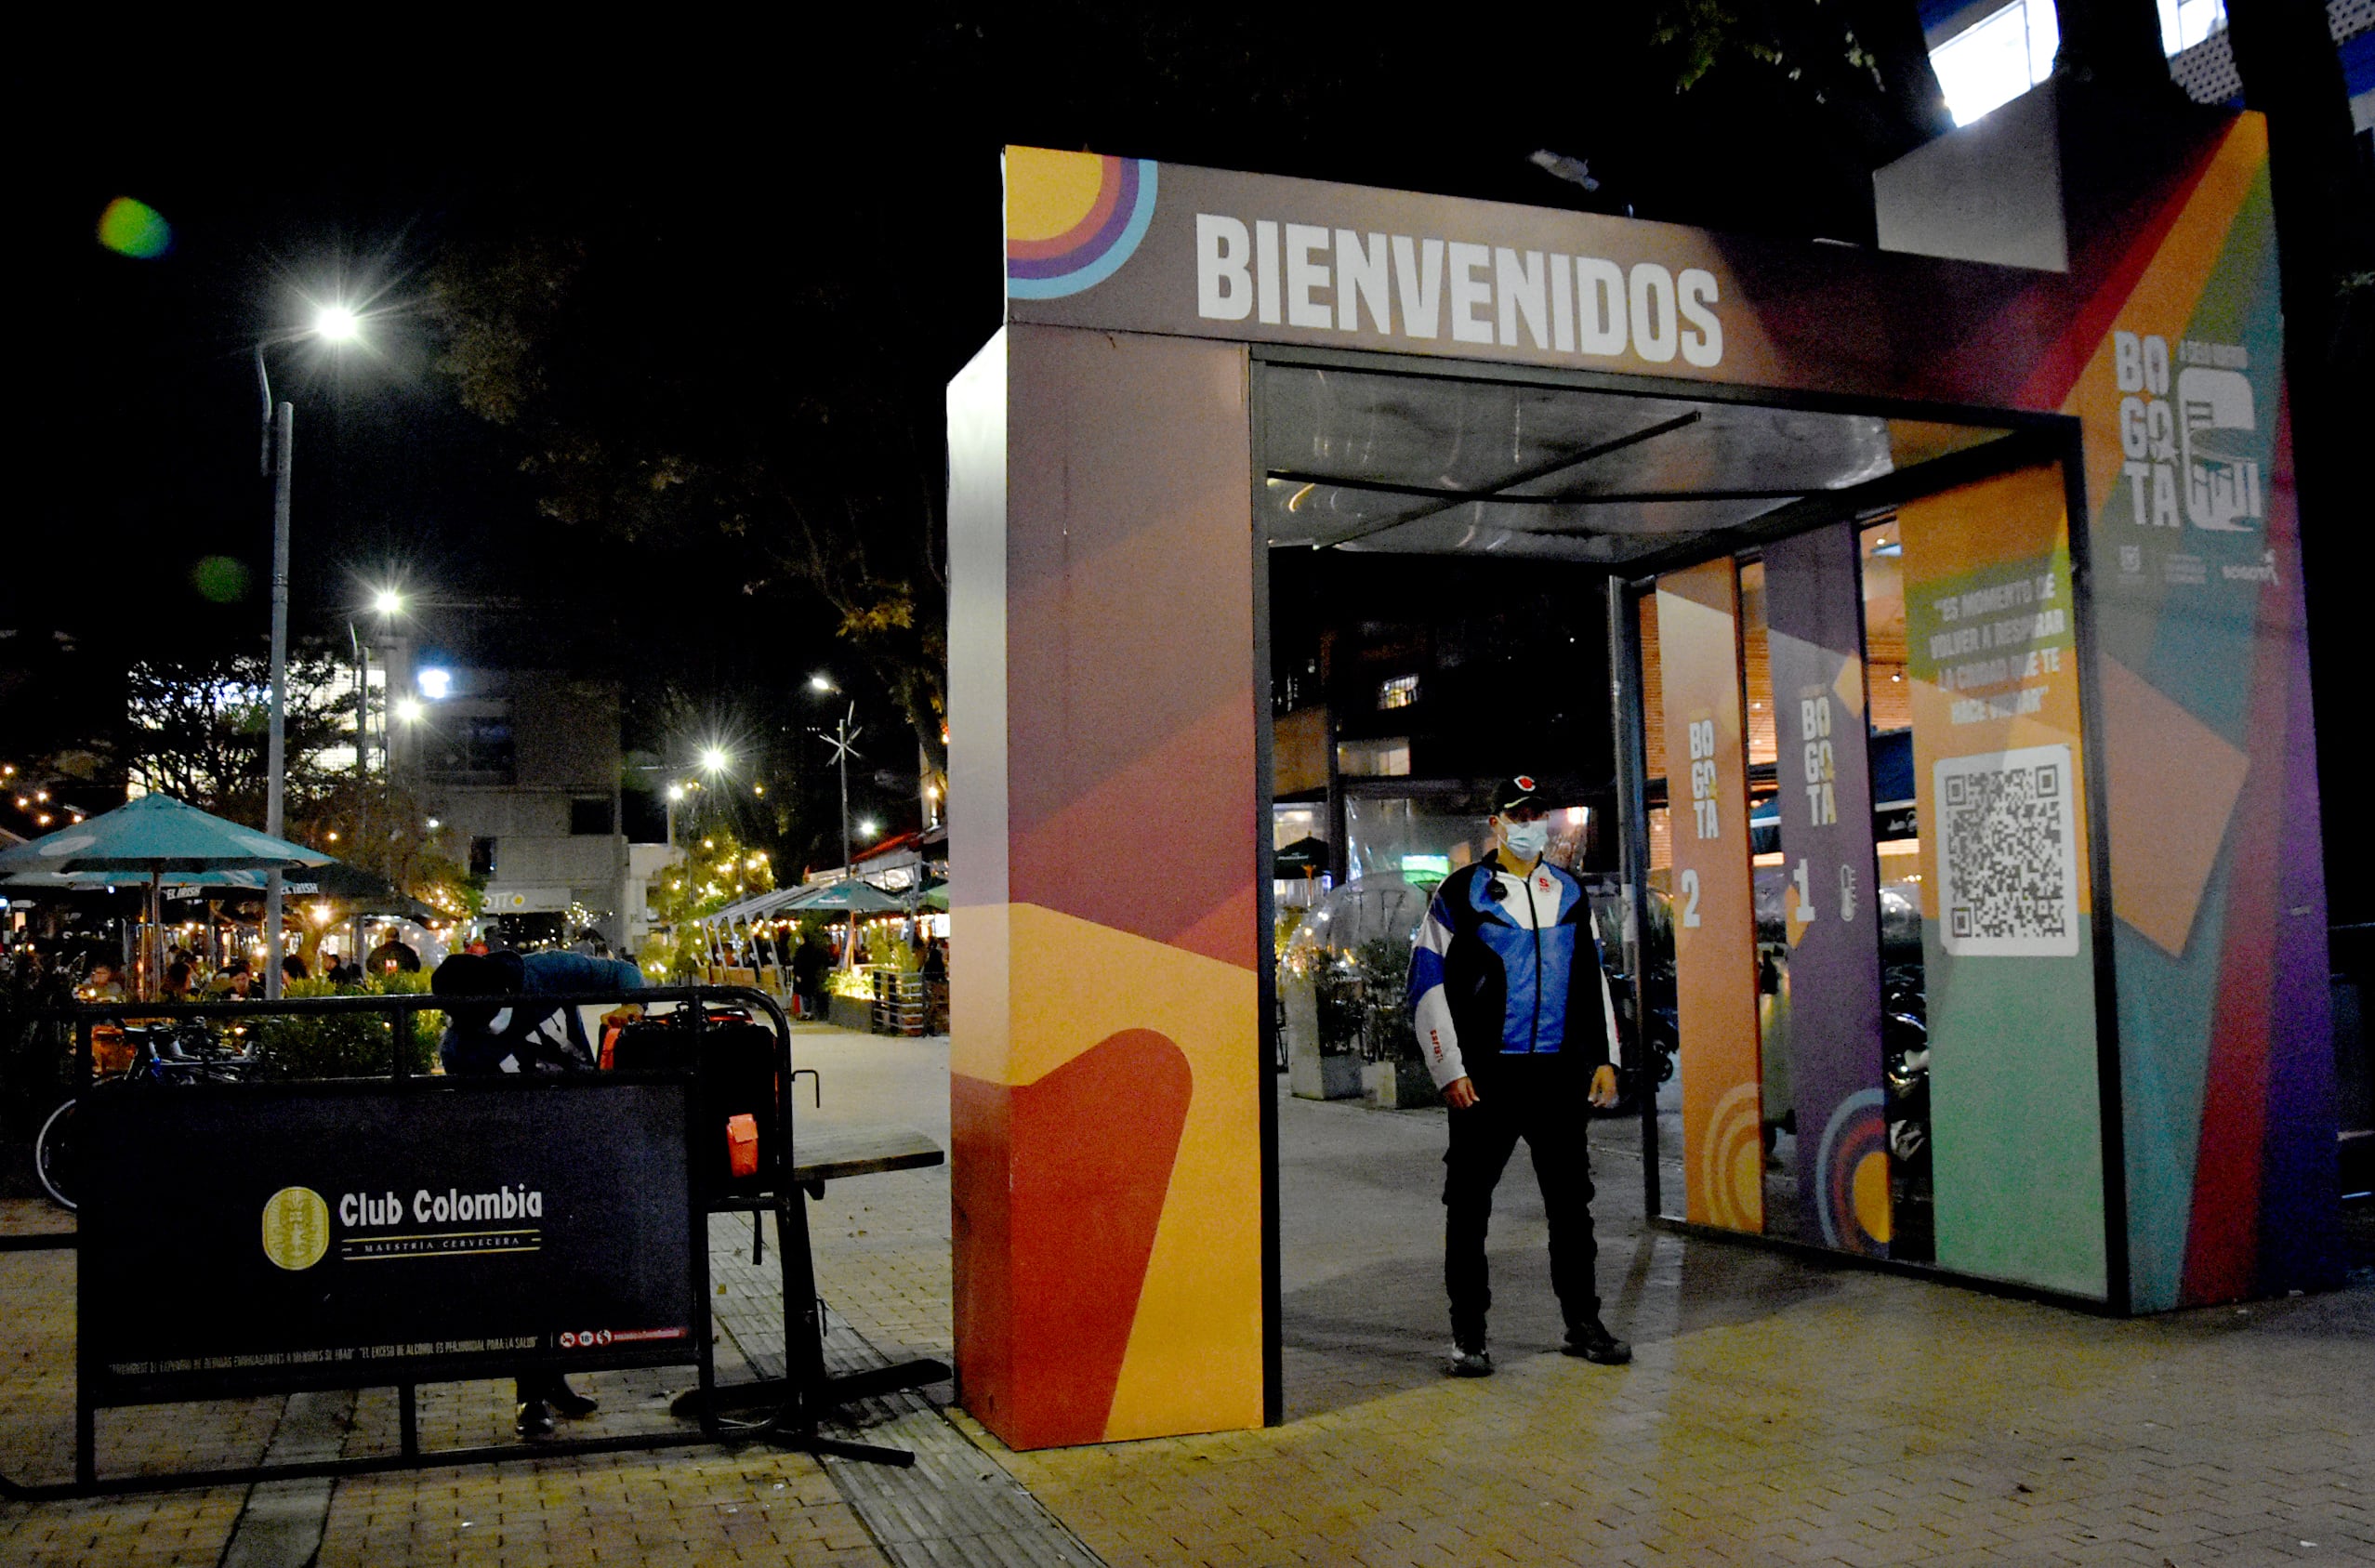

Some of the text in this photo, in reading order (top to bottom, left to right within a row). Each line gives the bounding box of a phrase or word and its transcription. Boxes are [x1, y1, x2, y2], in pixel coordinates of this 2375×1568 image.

[1195, 213, 1724, 368] BIENVENIDOS
[2114, 331, 2170, 396] BO
[1681, 869, 1701, 928] 2
[1793, 858, 1815, 922] 1
[339, 1182, 543, 1227] Club Colombia
[442, 1237, 521, 1248] CERVECERA
